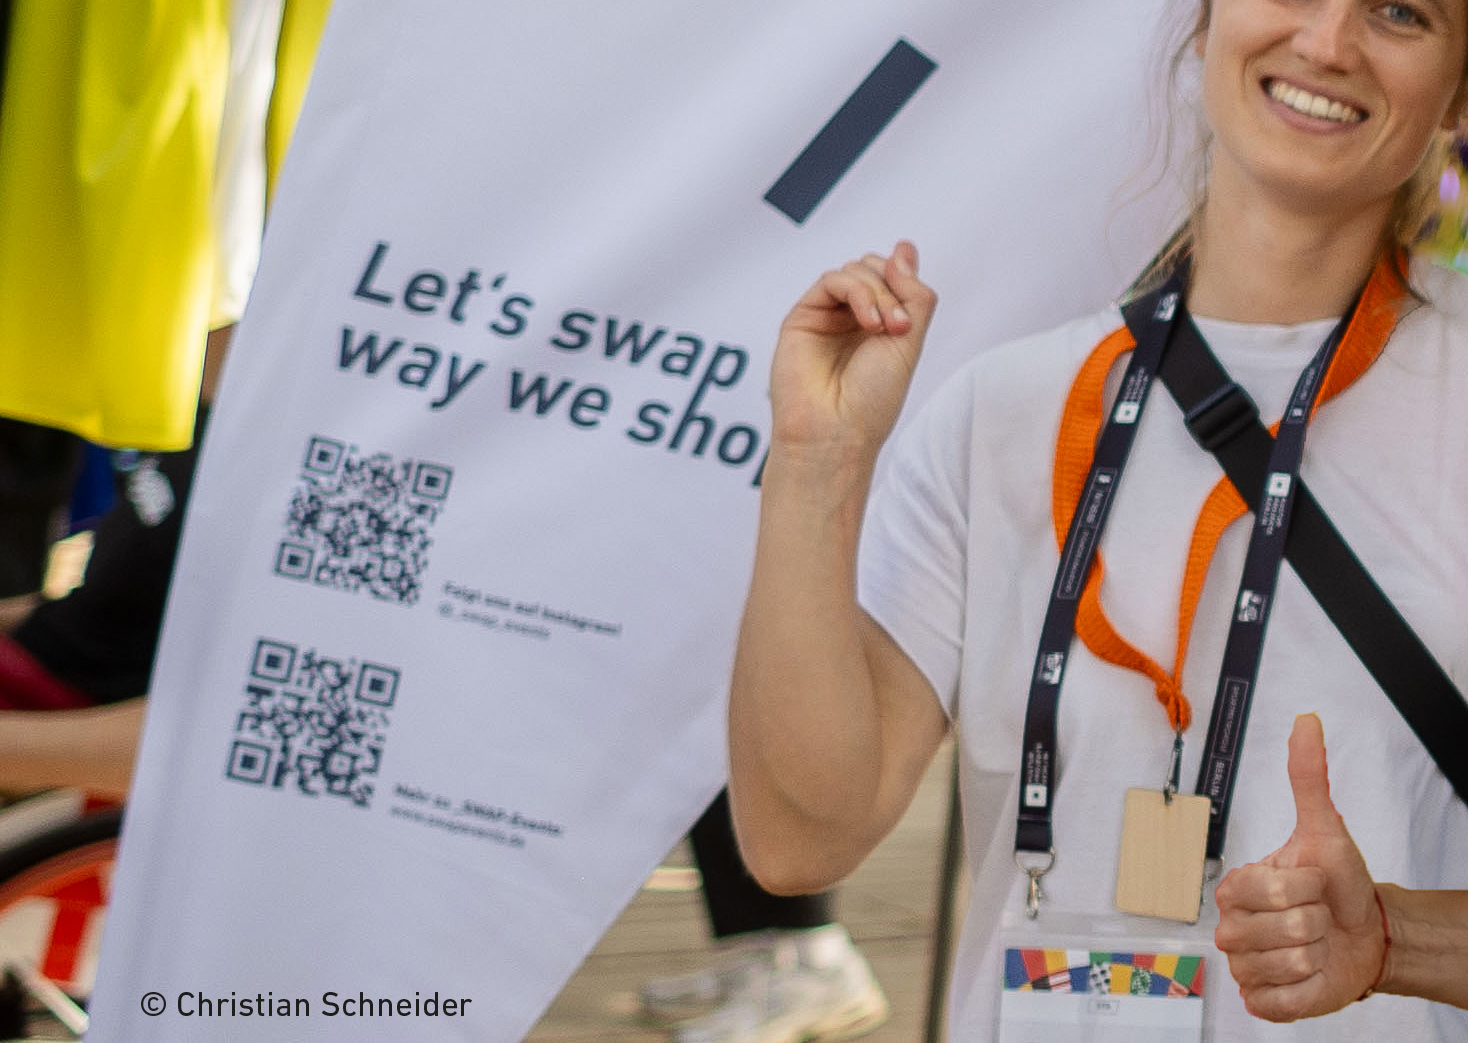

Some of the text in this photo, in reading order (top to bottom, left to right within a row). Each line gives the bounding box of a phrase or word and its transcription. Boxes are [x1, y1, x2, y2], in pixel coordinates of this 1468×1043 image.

[338, 325, 486, 410] way
[507, 368, 612, 429] we
[551, 307, 750, 413] swap
